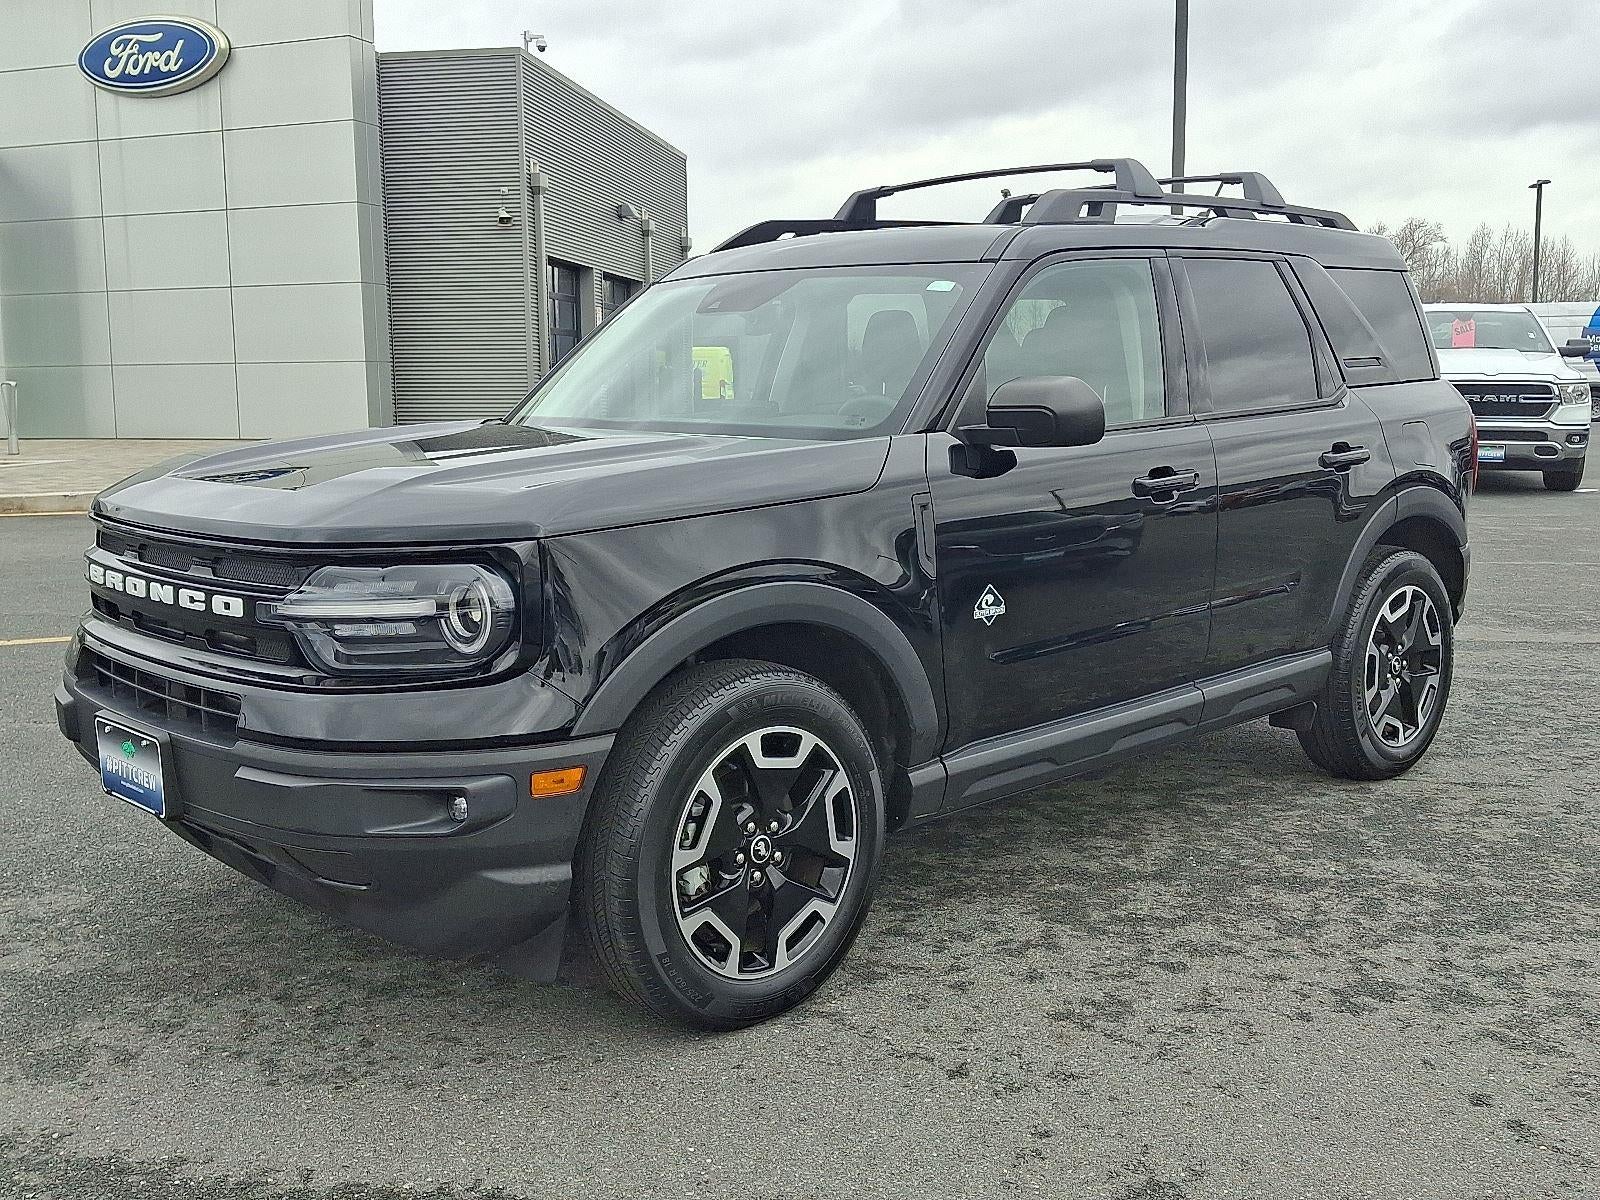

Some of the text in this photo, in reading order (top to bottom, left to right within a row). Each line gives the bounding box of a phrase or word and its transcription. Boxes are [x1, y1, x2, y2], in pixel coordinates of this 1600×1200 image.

[104, 32, 185, 79] Ford
[1454, 322, 1474, 336] SALE
[1464, 394, 1518, 403] RAM
[89, 563, 244, 618] BRONCO
[106, 754, 157, 792] #PITTCREW
